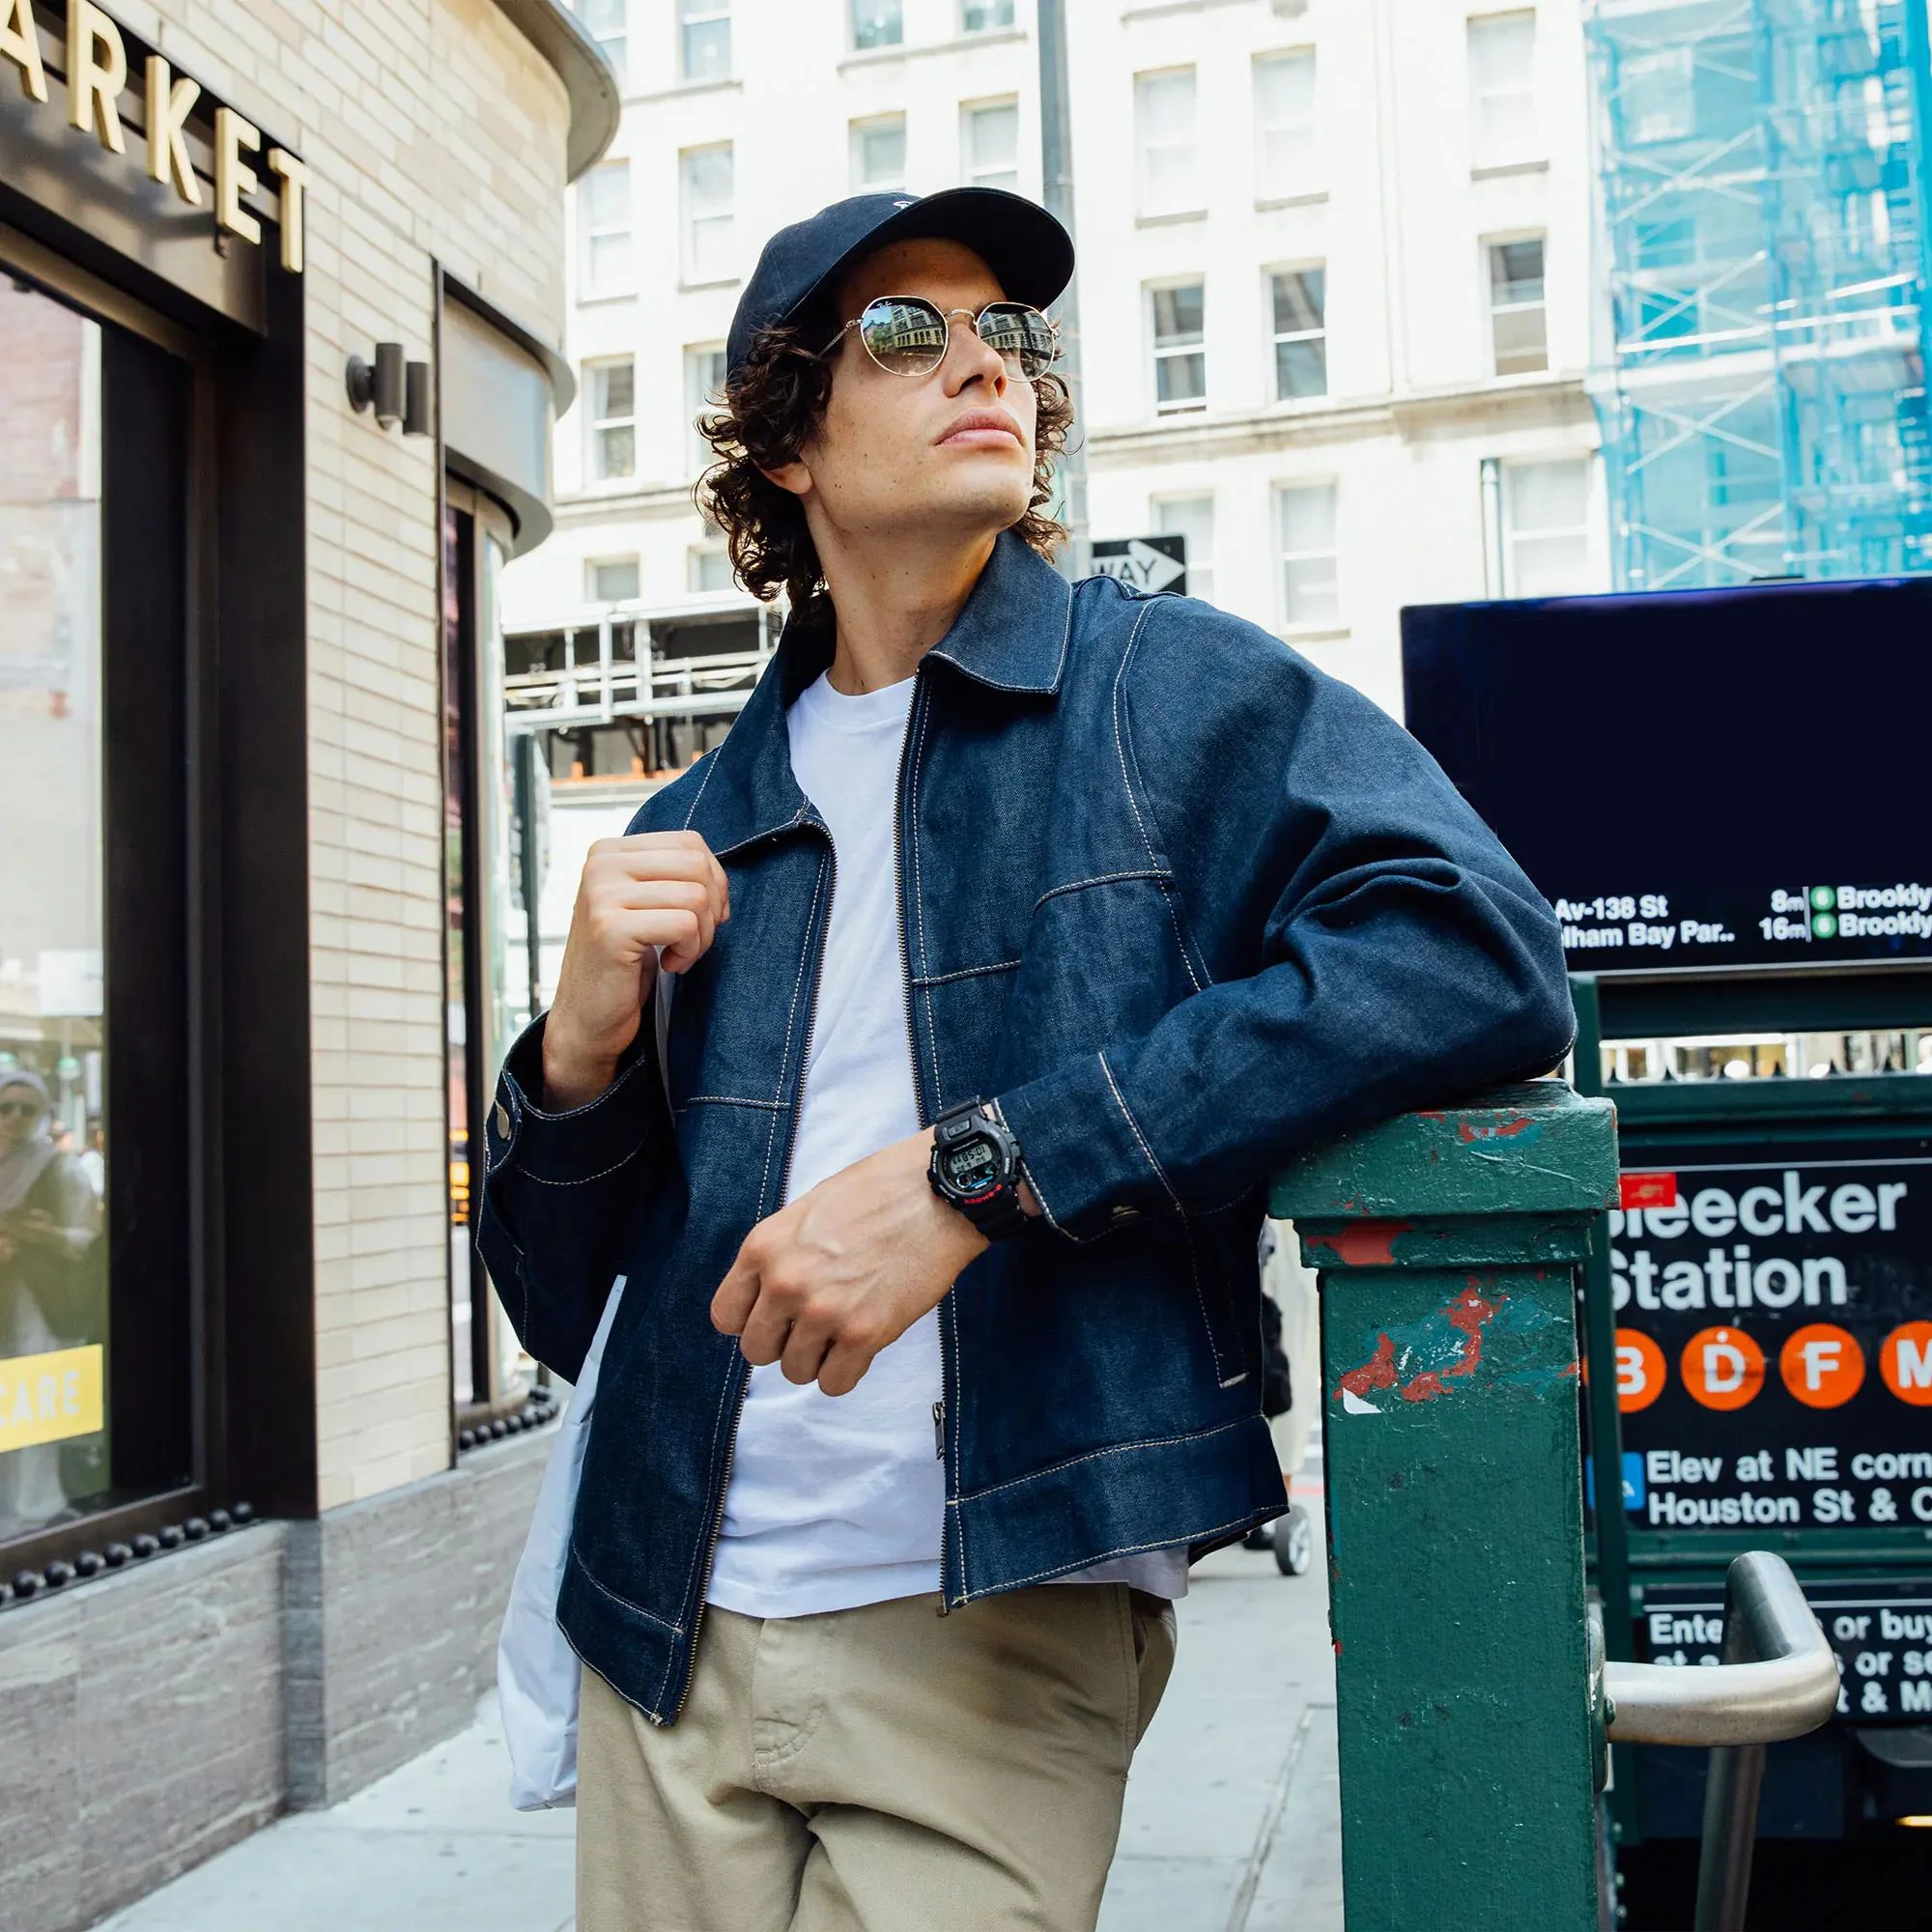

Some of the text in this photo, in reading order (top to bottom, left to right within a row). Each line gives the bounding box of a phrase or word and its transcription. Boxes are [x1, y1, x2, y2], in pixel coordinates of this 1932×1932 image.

[0, 0, 311, 273] ARKET
[1554, 896, 1636, 922] Av-138
[1639, 895, 1669, 919] St
[1562, 924, 1624, 949] lham
[1628, 923, 1676, 950] Bay
[1758, 917, 1806, 940] 16m
[1616, 1347, 1646, 1394] B
[1703, 1344, 1747, 1393] D
[1804, 1342, 1841, 1390] F
[0, 1371, 80, 1427] ARE
[1646, 1450, 1722, 1484] Elev
[1736, 1450, 1775, 1482] at
[1785, 1447, 1839, 1481] NE
[1648, 1492, 1801, 1524] Houston
[1812, 1488, 1857, 1522] St
[1868, 1487, 1900, 1522] &
[1833, 1615, 1871, 1640] or
[1855, 1651, 1893, 1677] or
[1861, 1681, 1889, 1713] &
